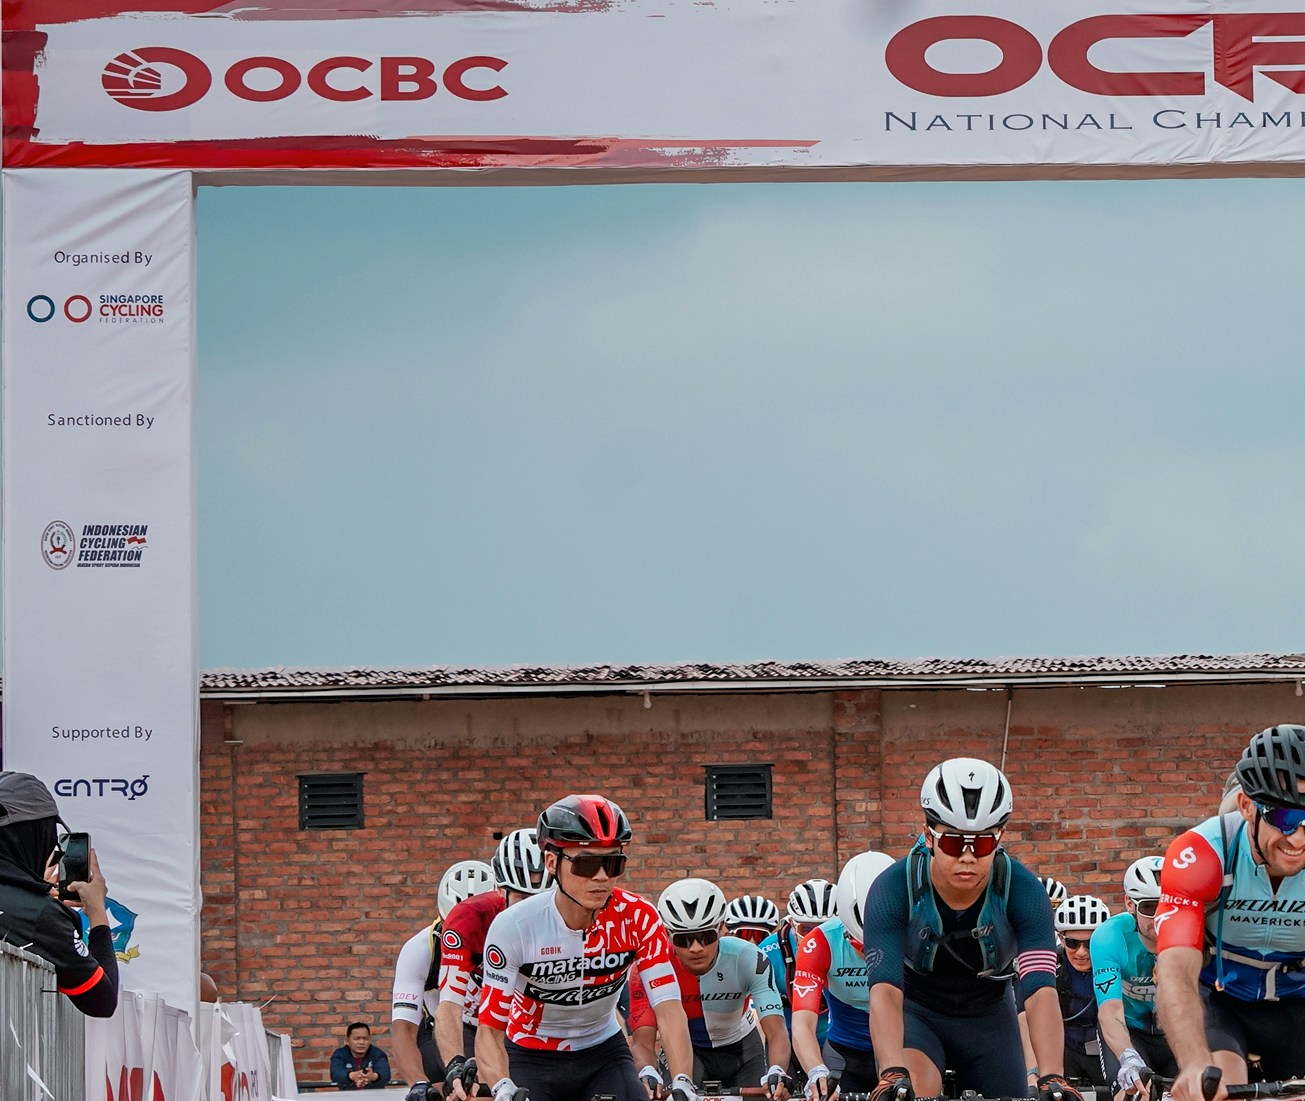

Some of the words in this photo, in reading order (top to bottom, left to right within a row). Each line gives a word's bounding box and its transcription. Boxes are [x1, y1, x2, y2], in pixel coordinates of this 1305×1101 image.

[223, 55, 510, 102] OCBC
[54, 251, 130, 267] Organised
[134, 251, 153, 267] By
[99, 294, 164, 304] SINGAPORE
[99, 304, 164, 317] CYCLING
[47, 413, 132, 427] Sanctioned
[136, 414, 155, 429] By
[82, 524, 148, 536] INDONESIAN
[79, 537, 127, 549] CYCLING
[78, 550, 143, 561] FEDERATION
[52, 726, 130, 741] Supported
[134, 726, 153, 742] By
[1159, 893, 1199, 907] ERICKS
[540, 946, 562, 956] GOBIK
[531, 948, 630, 976] matador
[529, 971, 576, 985] RACING
